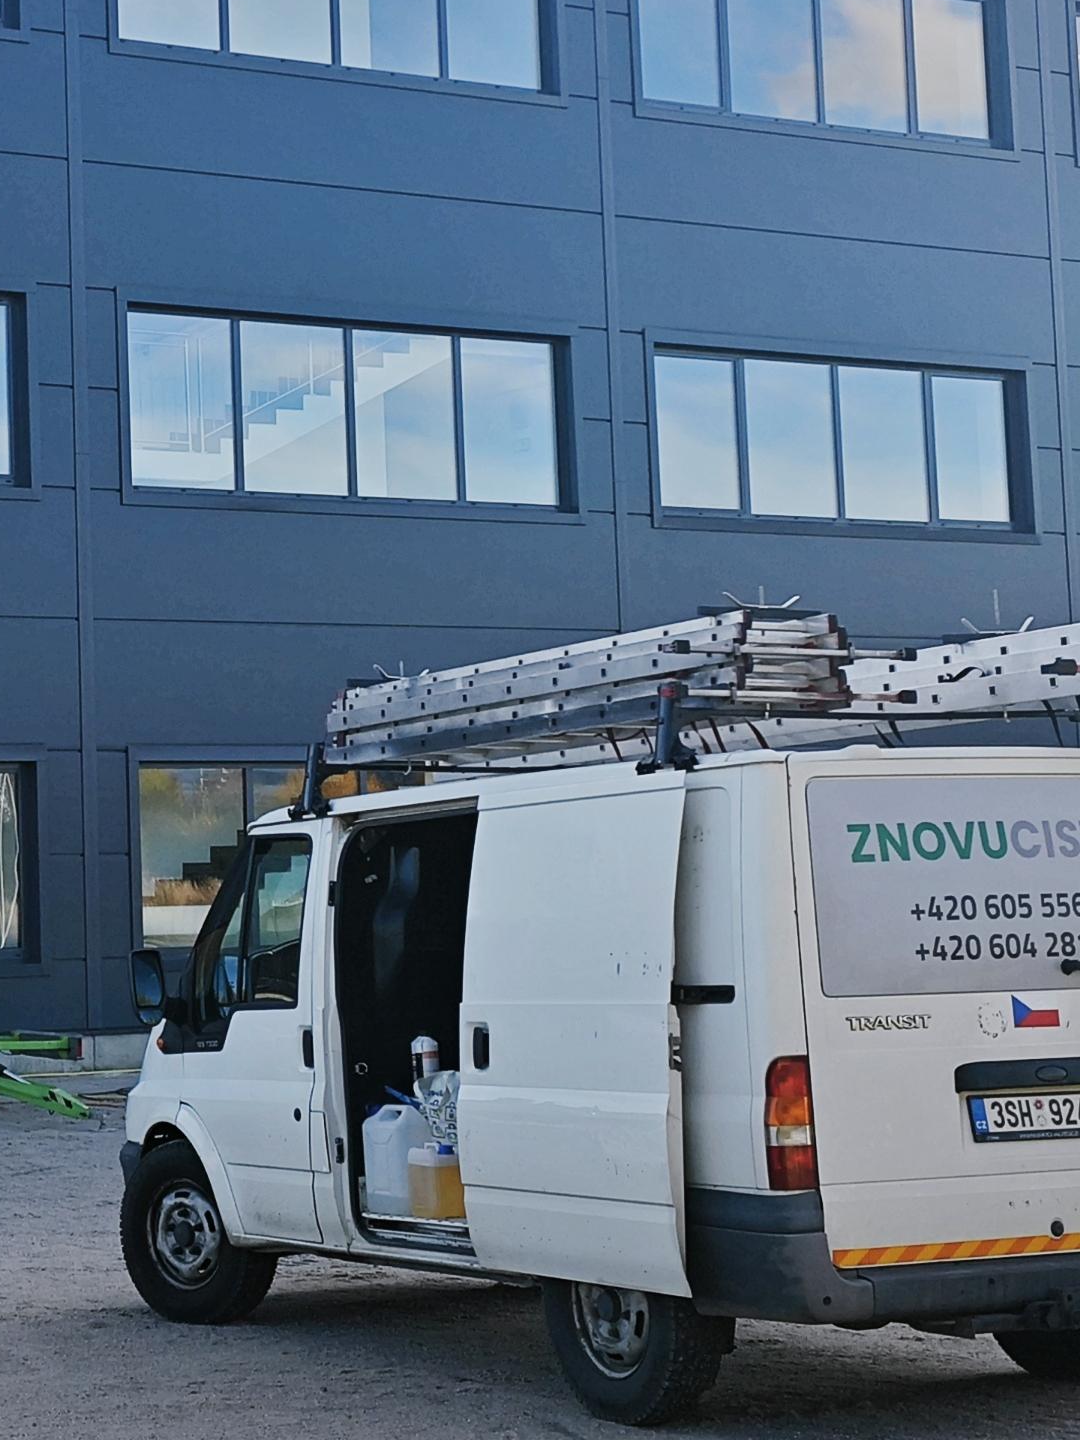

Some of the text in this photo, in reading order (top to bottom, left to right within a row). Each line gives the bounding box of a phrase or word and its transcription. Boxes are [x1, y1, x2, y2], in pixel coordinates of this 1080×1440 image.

[846, 820, 1080, 863] ZNOVUCIS
[910, 895, 977, 921] +420
[984, 893, 1033, 919] 605
[915, 932, 1080, 961] +420 604 28
[846, 1014, 932, 1032] TRANSIT
[976, 1121, 987, 1130] CZ
[990, 1098, 1080, 1128] 3SH 92
